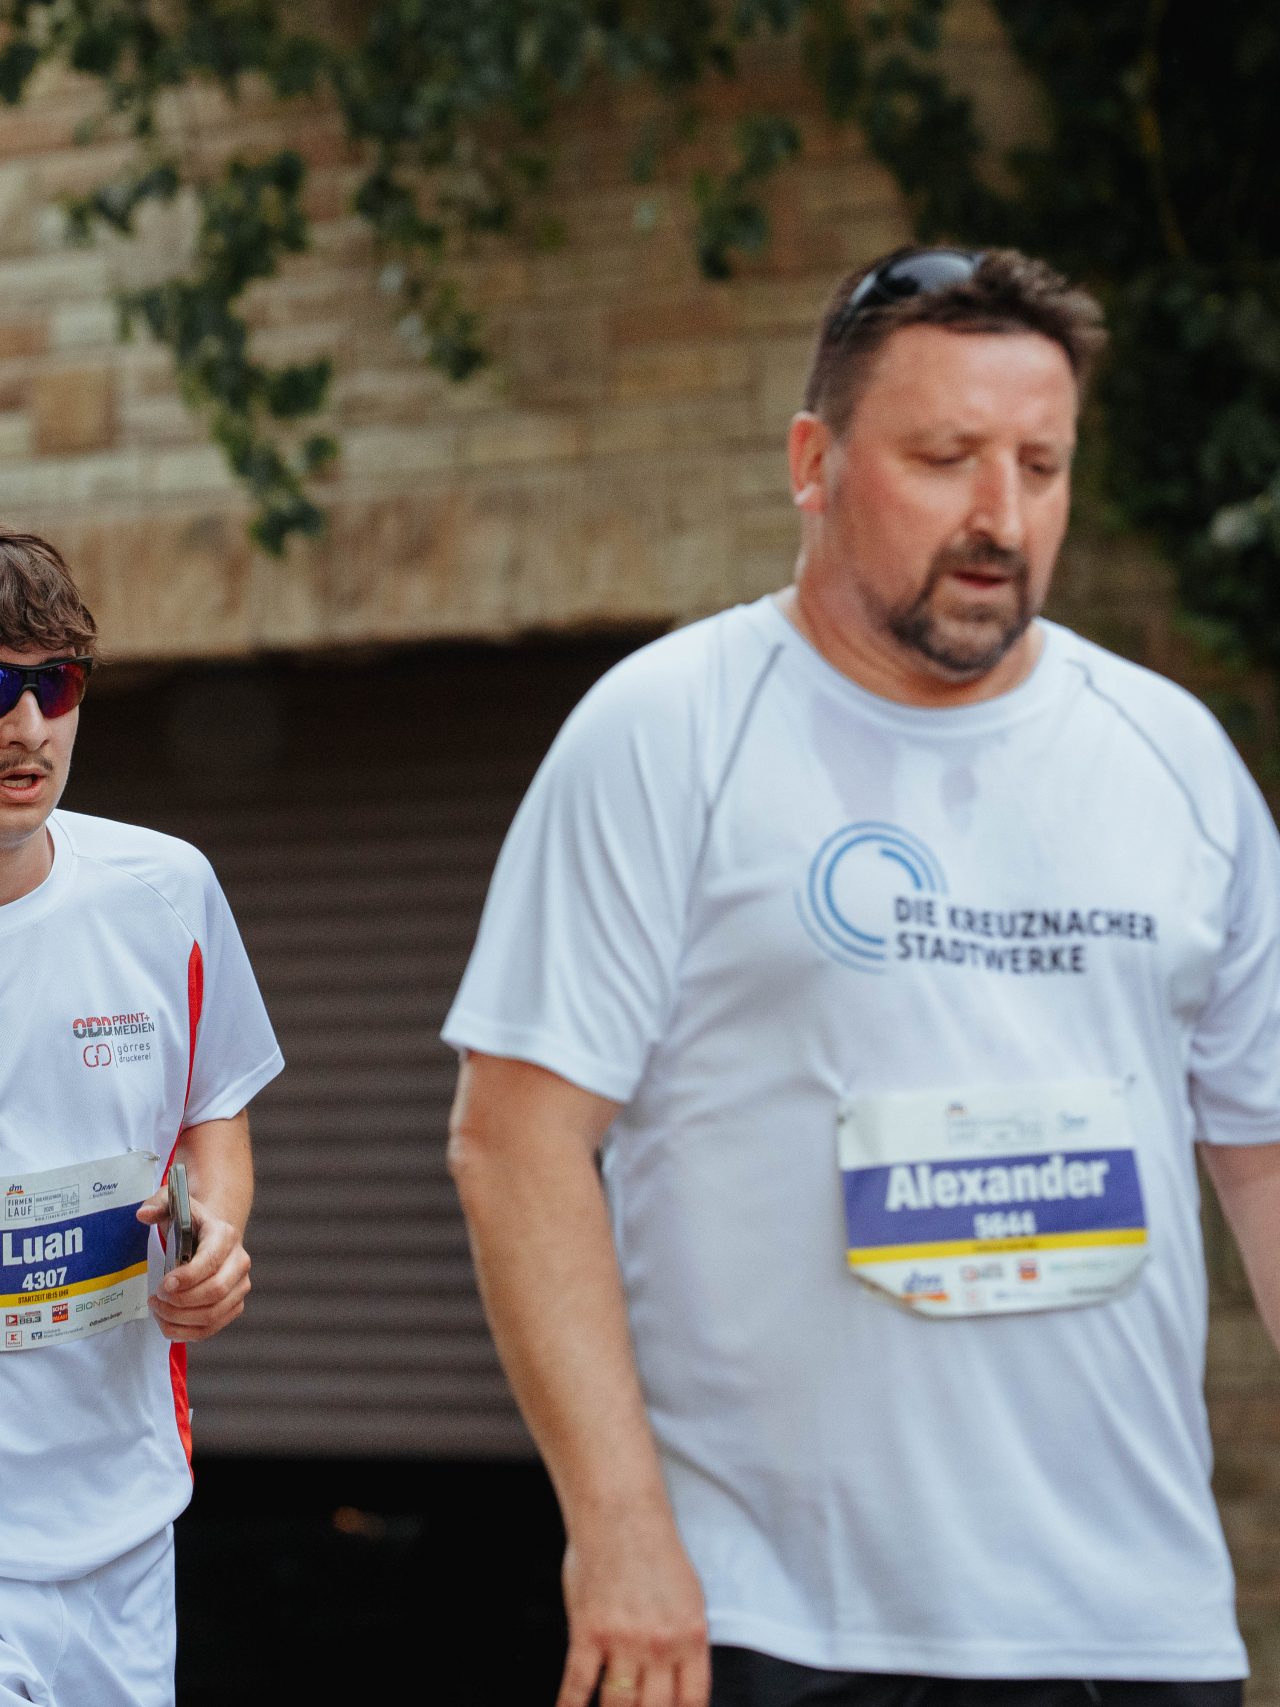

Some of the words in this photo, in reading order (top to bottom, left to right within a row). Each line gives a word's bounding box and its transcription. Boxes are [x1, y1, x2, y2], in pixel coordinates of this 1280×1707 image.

[894, 898, 938, 926] DIE
[948, 905, 1158, 942] KREUZNACHER
[896, 932, 1086, 974] STADTWERKE
[113, 1022, 155, 1036] MEDIEN
[117, 1042, 151, 1056] görres
[119, 1052, 152, 1063] druckerei
[884, 1154, 1110, 1212] Alexander
[7, 1197, 33, 1207] FIRMEN
[7, 1205, 32, 1218] LAUF
[2, 1227, 83, 1266] Luan
[22, 1266, 68, 1291] 4307
[17, 1293, 45, 1304] STARTZEIT
[75, 1290, 124, 1313] BIONTECH
